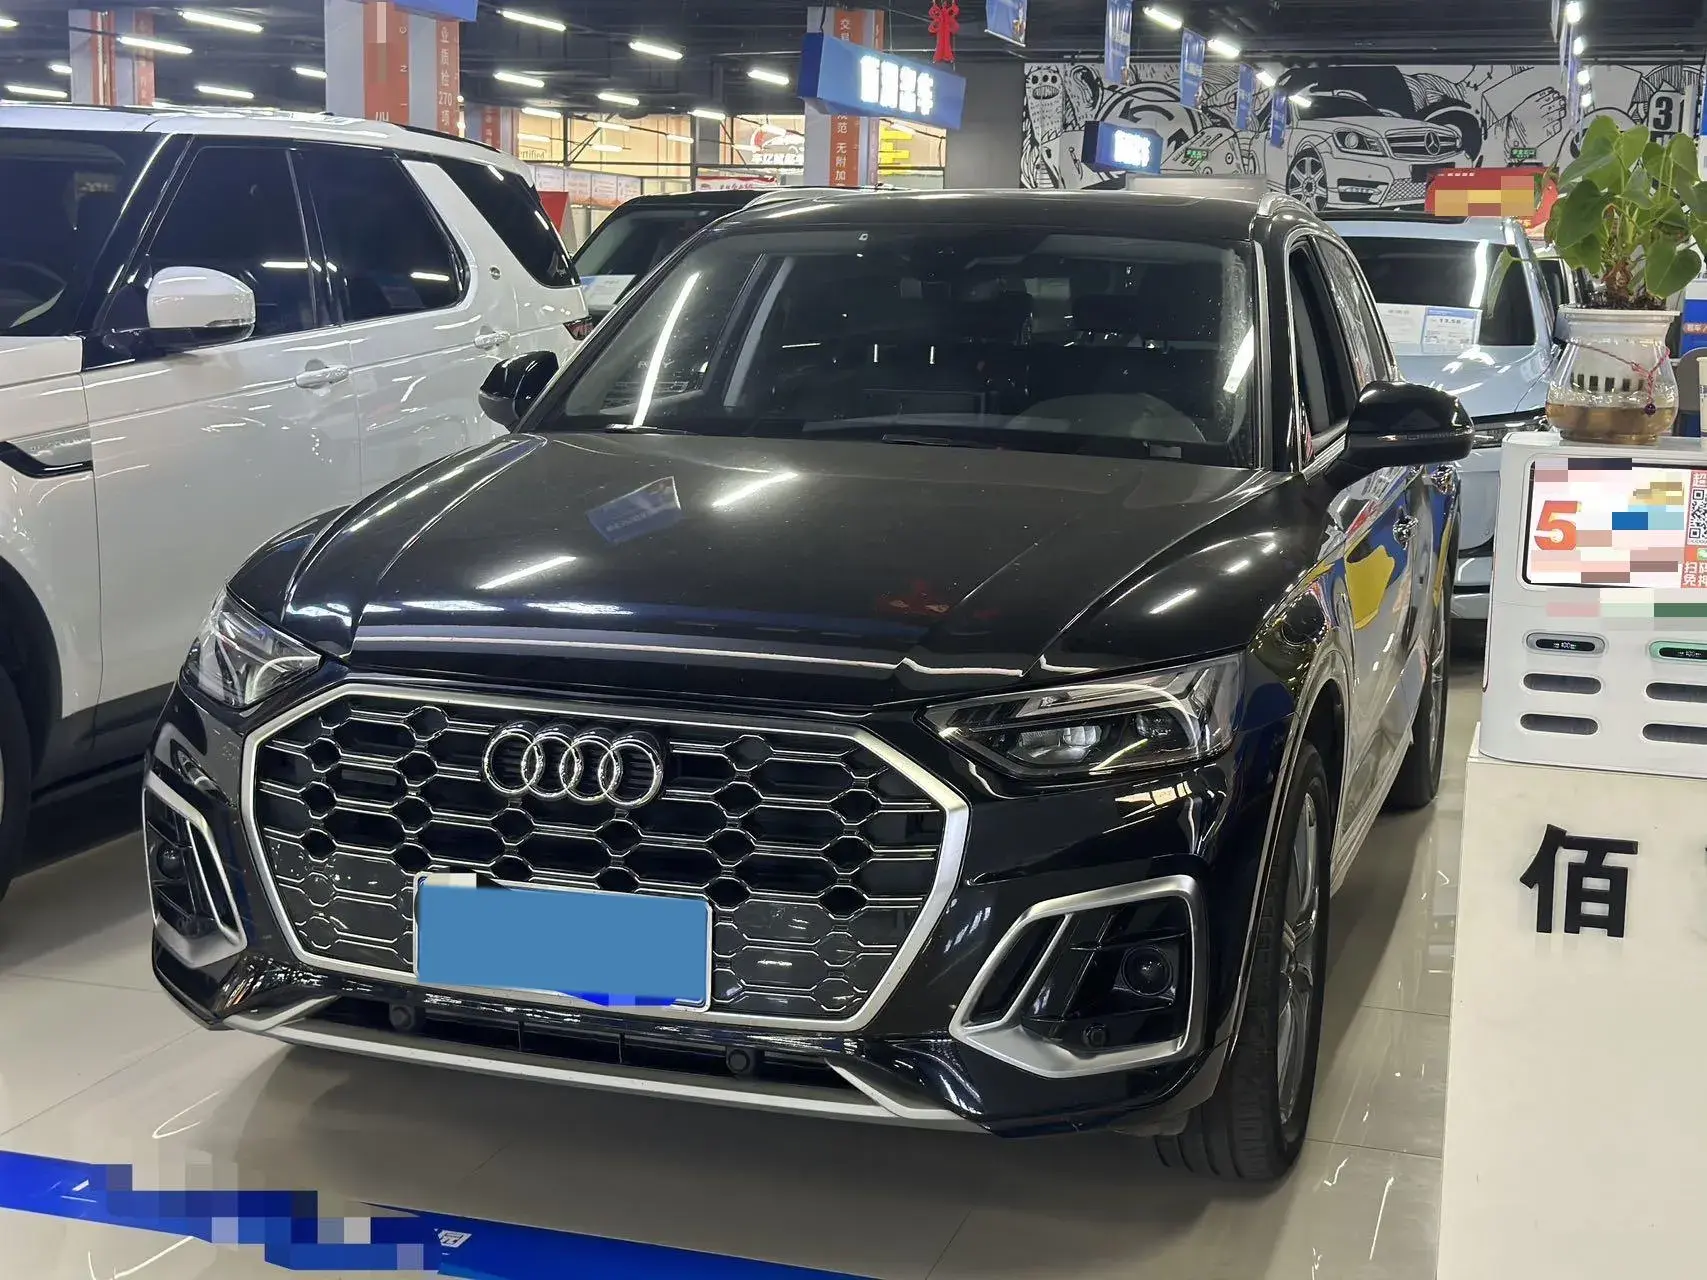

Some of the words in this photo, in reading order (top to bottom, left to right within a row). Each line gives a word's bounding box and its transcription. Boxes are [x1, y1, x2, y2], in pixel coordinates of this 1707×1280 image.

[834, 142, 847, 187] 无附加
[1533, 500, 1578, 550] 5
[1519, 823, 1639, 938] 佰
